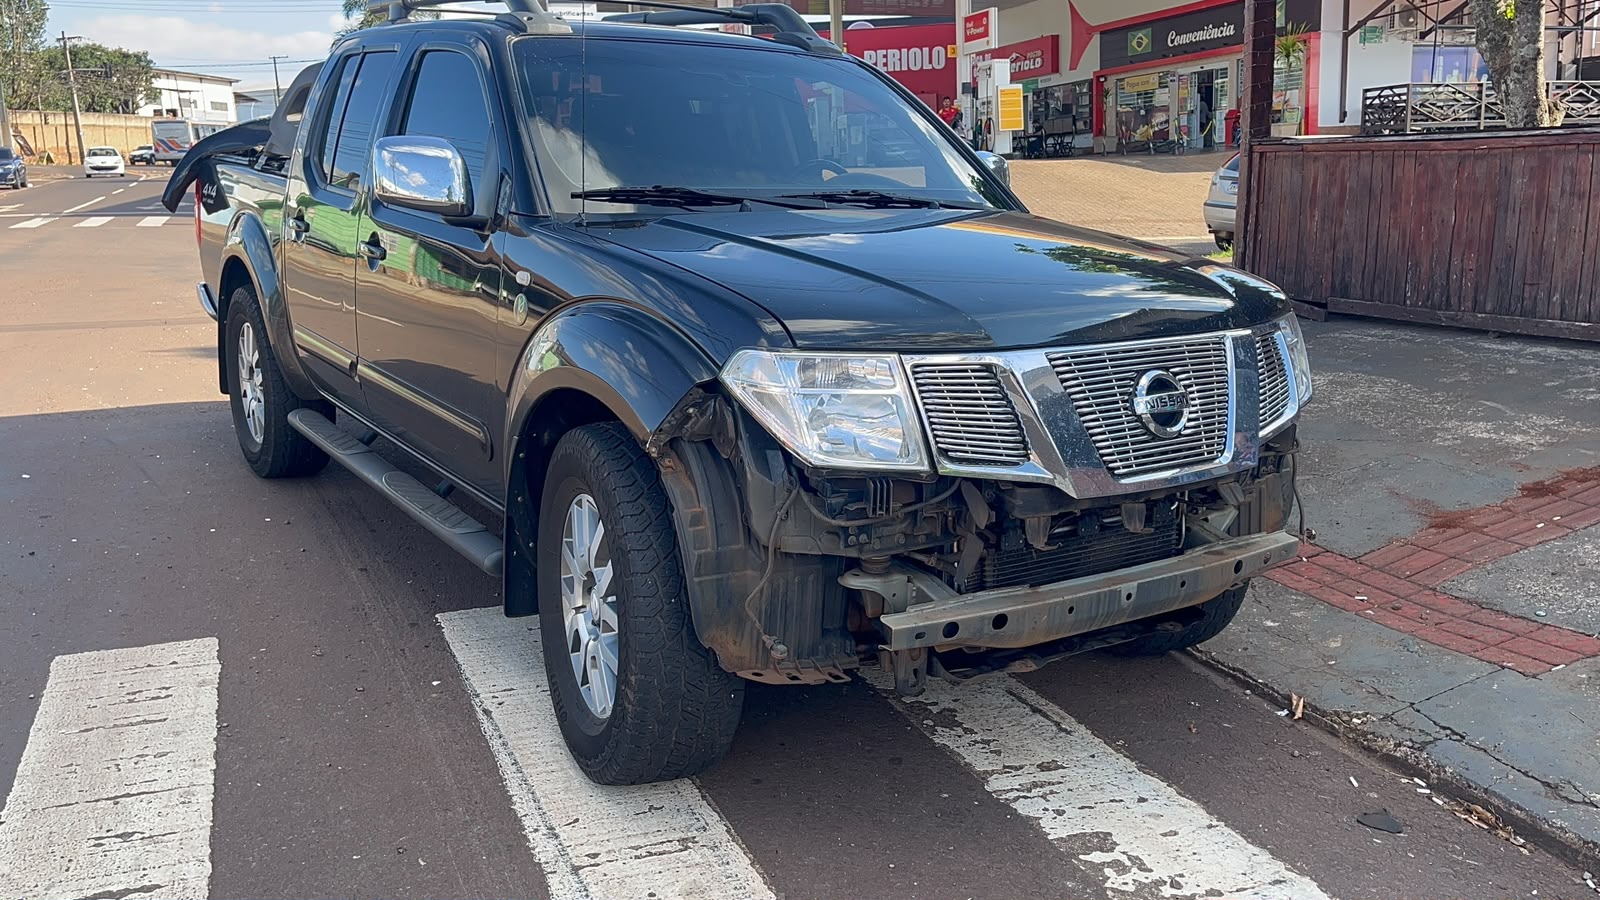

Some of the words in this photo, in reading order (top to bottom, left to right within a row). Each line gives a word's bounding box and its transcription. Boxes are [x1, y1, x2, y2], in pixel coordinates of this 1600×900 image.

[1167, 22, 1235, 47] Conveniência
[863, 46, 946, 72] PERIOLO
[202, 183, 217, 198] 4x4
